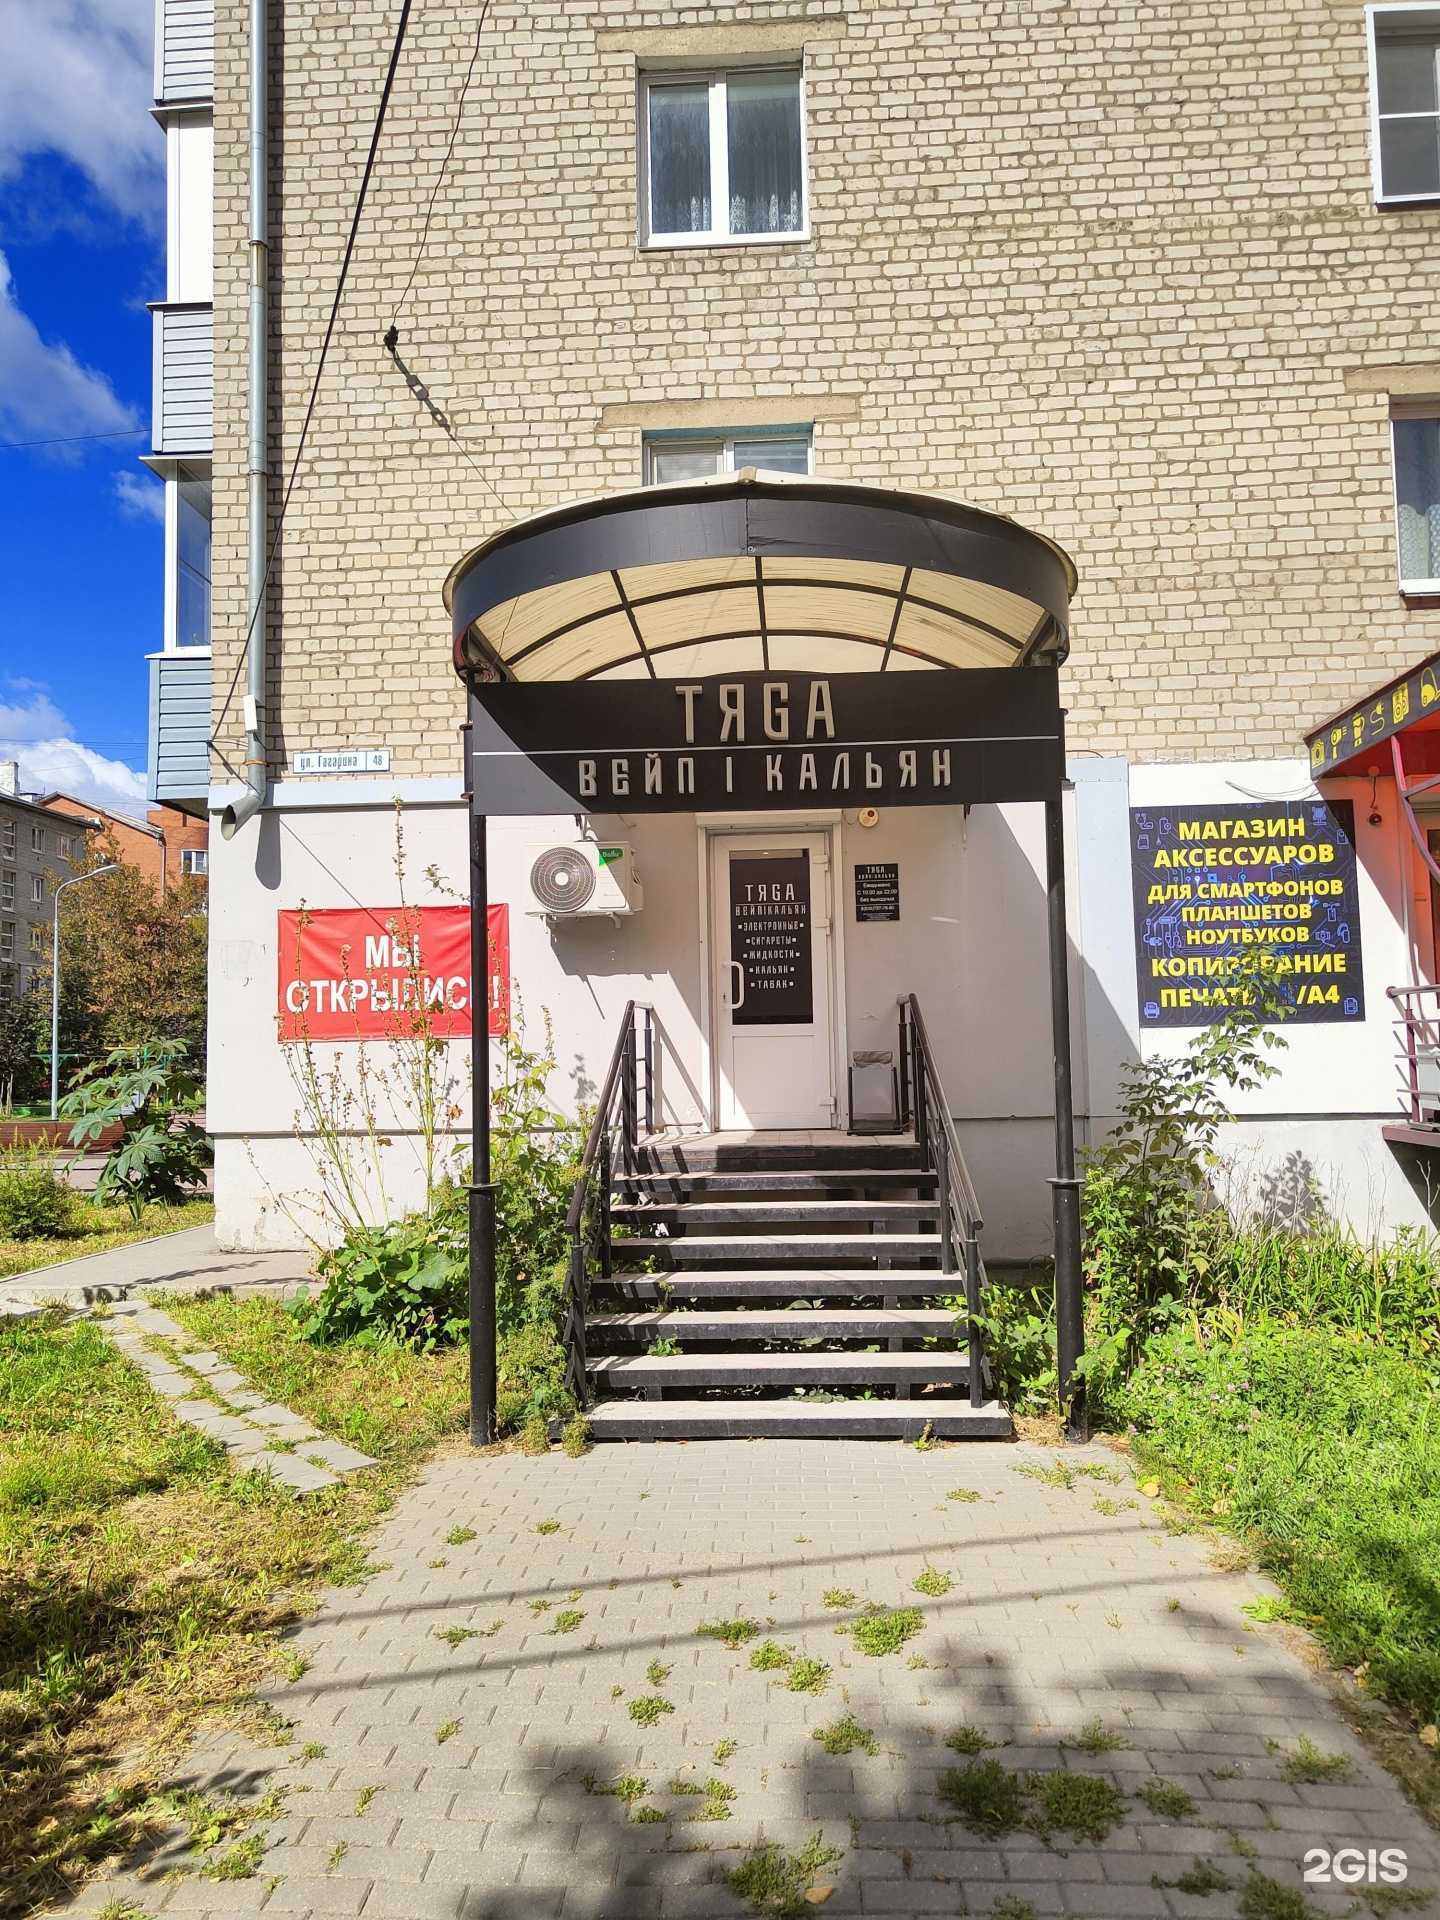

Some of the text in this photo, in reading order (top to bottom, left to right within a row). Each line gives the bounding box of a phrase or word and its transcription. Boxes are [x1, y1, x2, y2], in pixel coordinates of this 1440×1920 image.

[300, 755, 383, 770] ул. Гагарина 48
[578, 753, 696, 796] ВЕЙП
[766, 748, 952, 793] КАЛЬЯН
[1178, 818, 1305, 841] МАГАЗИН
[1153, 844, 1335, 868] АКСЕССУАРОВ
[1148, 880, 1344, 904] ДЛЯ СМАРТФОНОВ
[1182, 904, 1312, 922] ПЛАНШЕТОВ
[743, 920, 799, 932] ЭЛЕКТРОННЫЕ
[751, 936, 792, 946] СИГАРЕТЫ
[1186, 927, 1310, 945] НОУТБУКОВ
[365, 934, 420, 969] МЫ
[749, 949, 794, 960] ЖИДКОСТИ
[755, 964, 788, 975] КАЛЬЯН
[286, 975, 500, 1013] ОТКРЫЛИС!
[757, 980, 788, 990] ТАБАК
